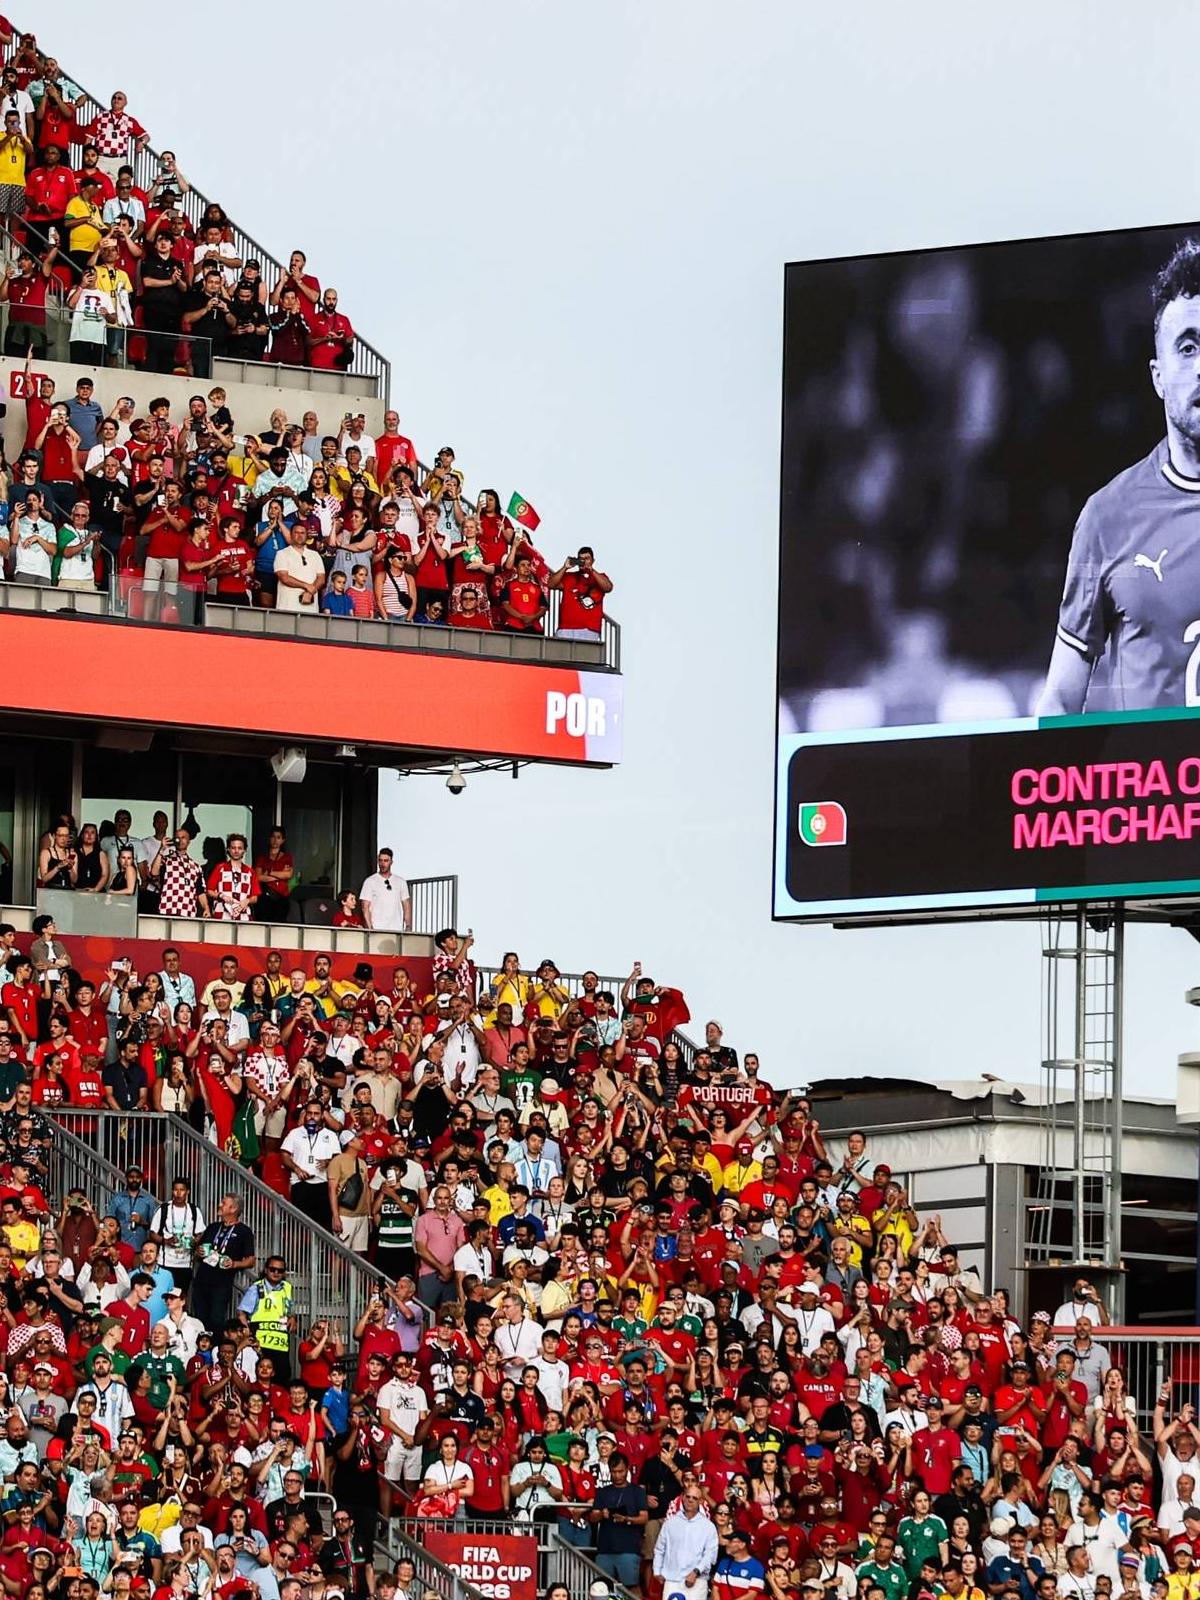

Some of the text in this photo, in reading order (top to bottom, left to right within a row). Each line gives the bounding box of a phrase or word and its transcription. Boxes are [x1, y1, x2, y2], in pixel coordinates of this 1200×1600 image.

[14, 374, 42, 398] 21
[1011, 760, 1171, 806] CONTRA
[692, 1086, 759, 1104] PORTUGAL
[463, 1546, 501, 1563] FIFA
[438, 1564, 532, 1582] ORLD CUP
